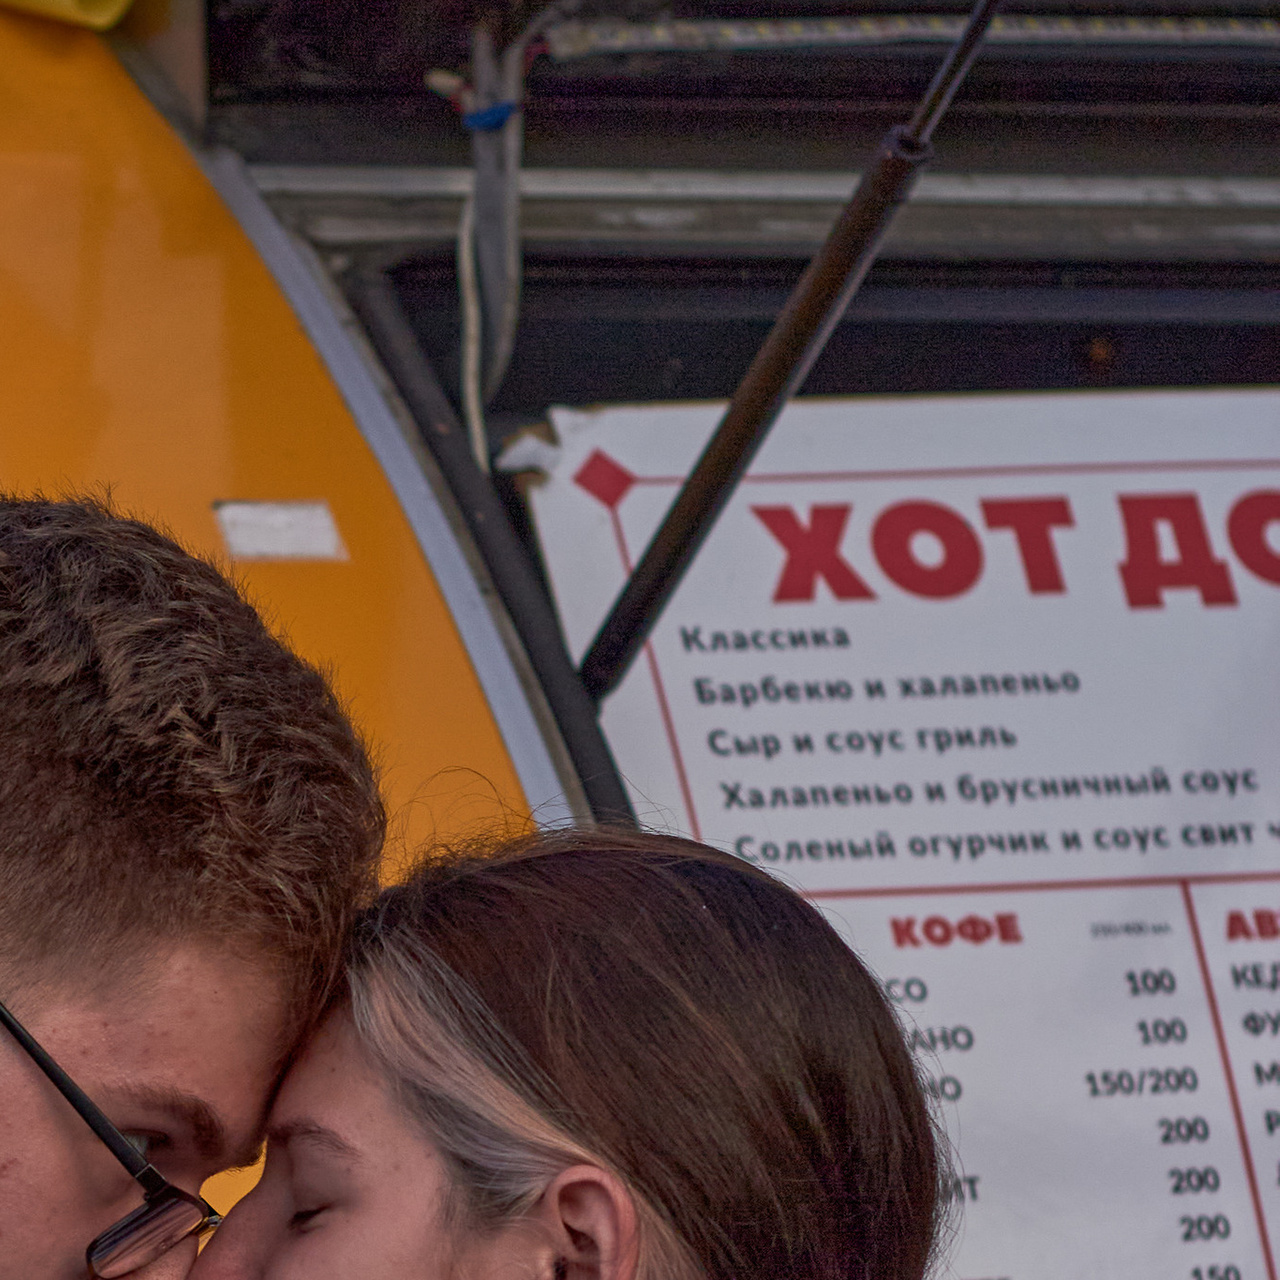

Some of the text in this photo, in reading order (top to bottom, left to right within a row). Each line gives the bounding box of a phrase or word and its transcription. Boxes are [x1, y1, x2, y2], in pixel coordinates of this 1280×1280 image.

[750, 495, 1076, 605] ХОТ
[679, 626, 851, 653] Классика
[692, 671, 1081, 709] Барбекю и халапеньо
[706, 726, 1018, 761] Сыр и соус гриль
[719, 766, 1258, 810] Халапеньо и брусничный соус
[734, 832, 898, 863] Соленый
[907, 831, 1050, 861] огурчик
[1060, 831, 1083, 851] и
[1093, 825, 1170, 854] соус
[1180, 823, 1253, 847] свит
[889, 912, 1023, 949] КОФЕ
[1125, 968, 1177, 997] 100
[1137, 1017, 1188, 1046] 100
[1085, 1066, 1199, 1098] 150/200
[1158, 1116, 1211, 1146] 200
[1168, 1166, 1221, 1196] 200
[1179, 1213, 1232, 1243] 200
